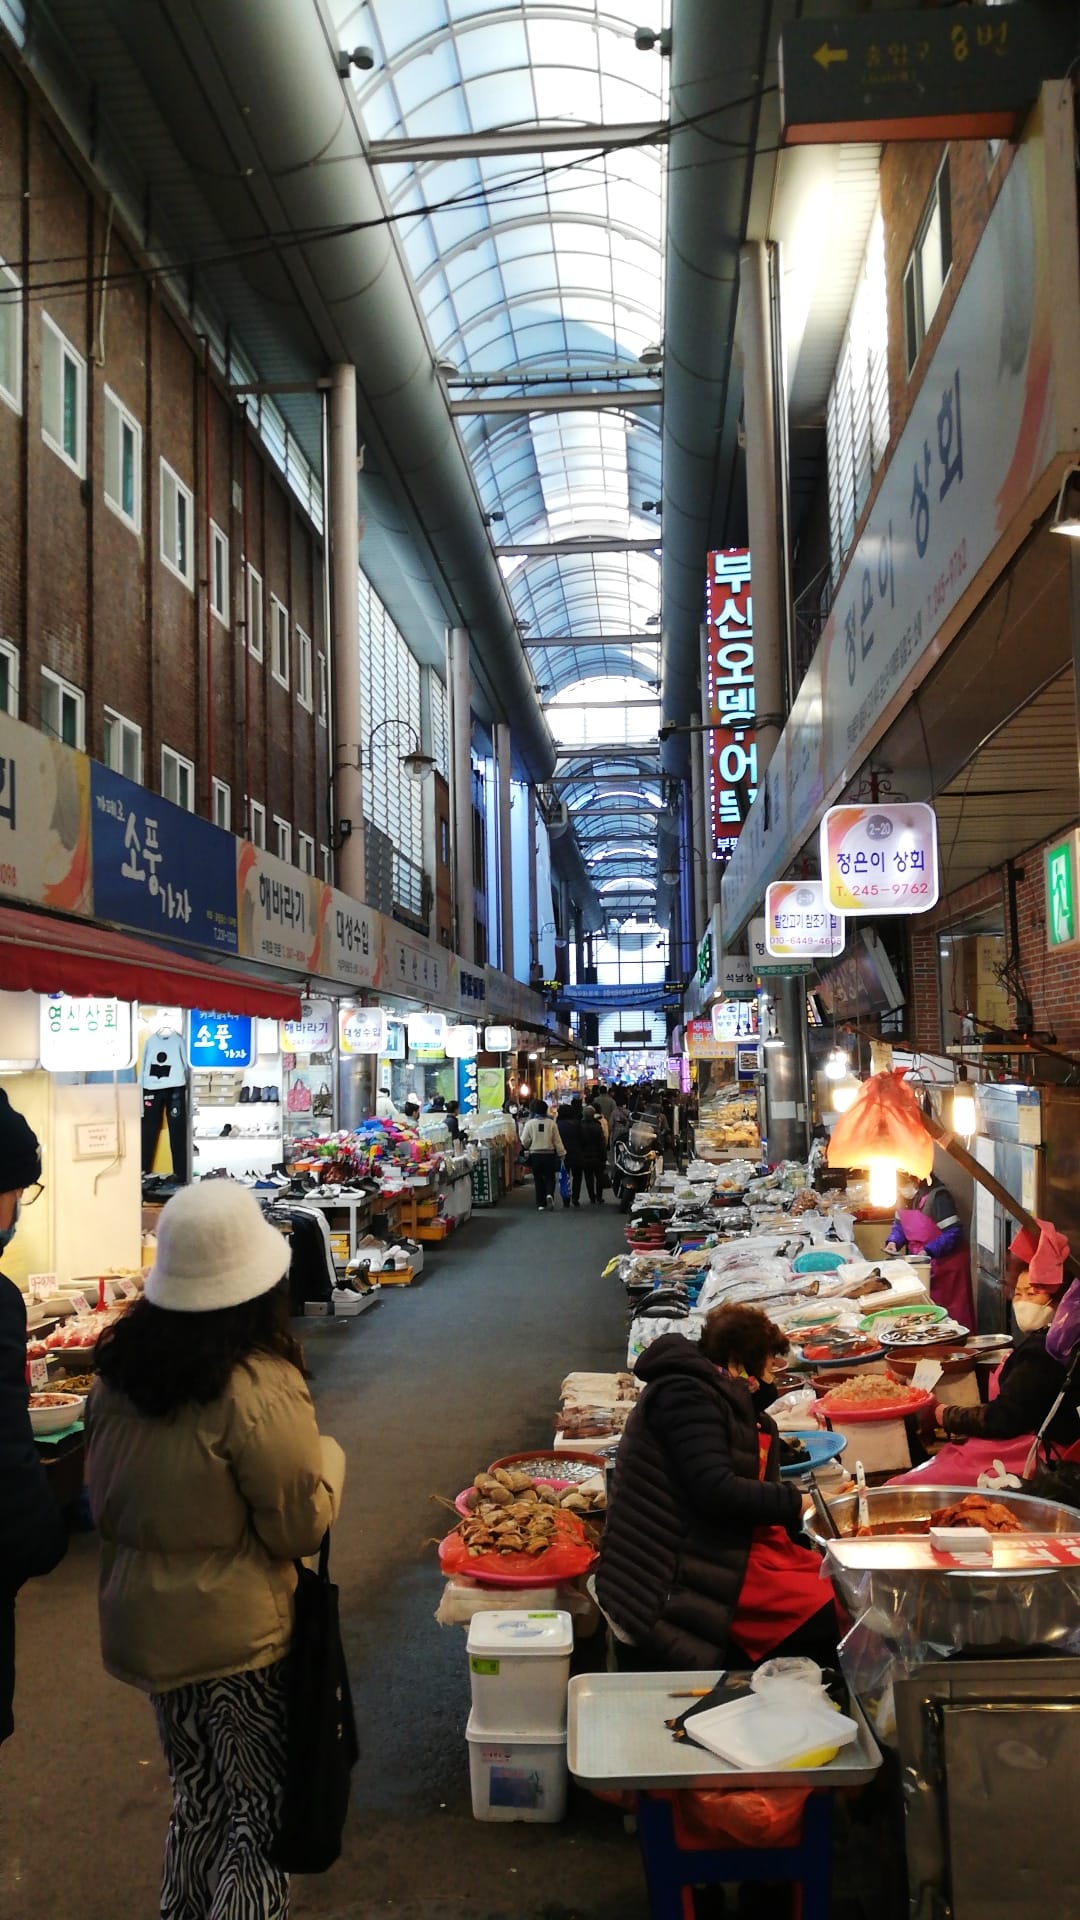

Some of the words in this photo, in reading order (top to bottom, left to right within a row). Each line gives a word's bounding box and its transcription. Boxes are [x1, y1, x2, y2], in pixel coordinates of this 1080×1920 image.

[910, 367, 964, 559] 상회
[868, 821, 891, 835] 2-20
[121, 812, 162, 896] 소풍
[893, 849, 925, 873] 상회
[852, 882, 928, 896] 245-9762
[159, 883, 192, 923] 가자
[258, 872, 306, 933] 해바라기
[336, 910, 369, 956] 대성수입
[193, 1024, 233, 1050] 소풍
[343, 1027, 381, 1038] 대성수입
[224, 1049, 247, 1059] 가자
